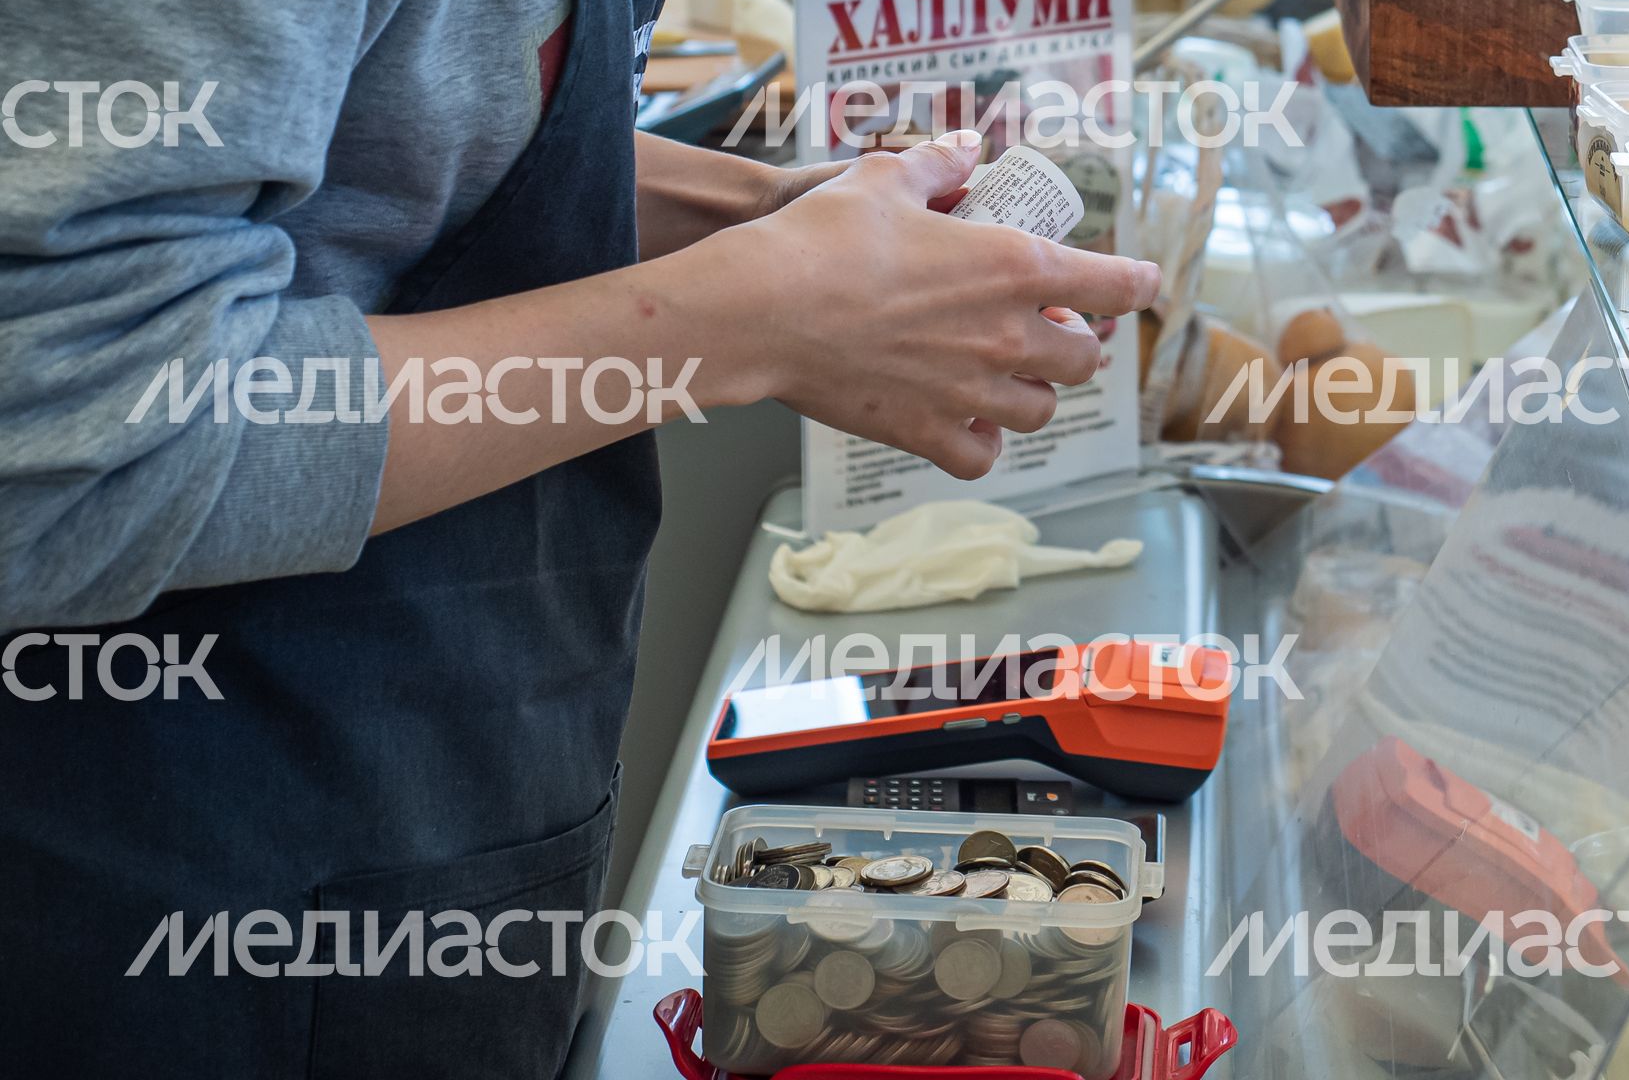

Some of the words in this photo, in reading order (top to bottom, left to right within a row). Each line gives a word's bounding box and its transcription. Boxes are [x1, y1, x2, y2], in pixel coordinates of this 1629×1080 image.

[827, 52, 938, 84] КИПРСКИЙ
[950, 49, 989, 69] СЫР
[1015, 167, 1041, 194] Терминал:
[1033, 171, 1047, 186] Дата
[1011, 190, 1028, 209] время:
